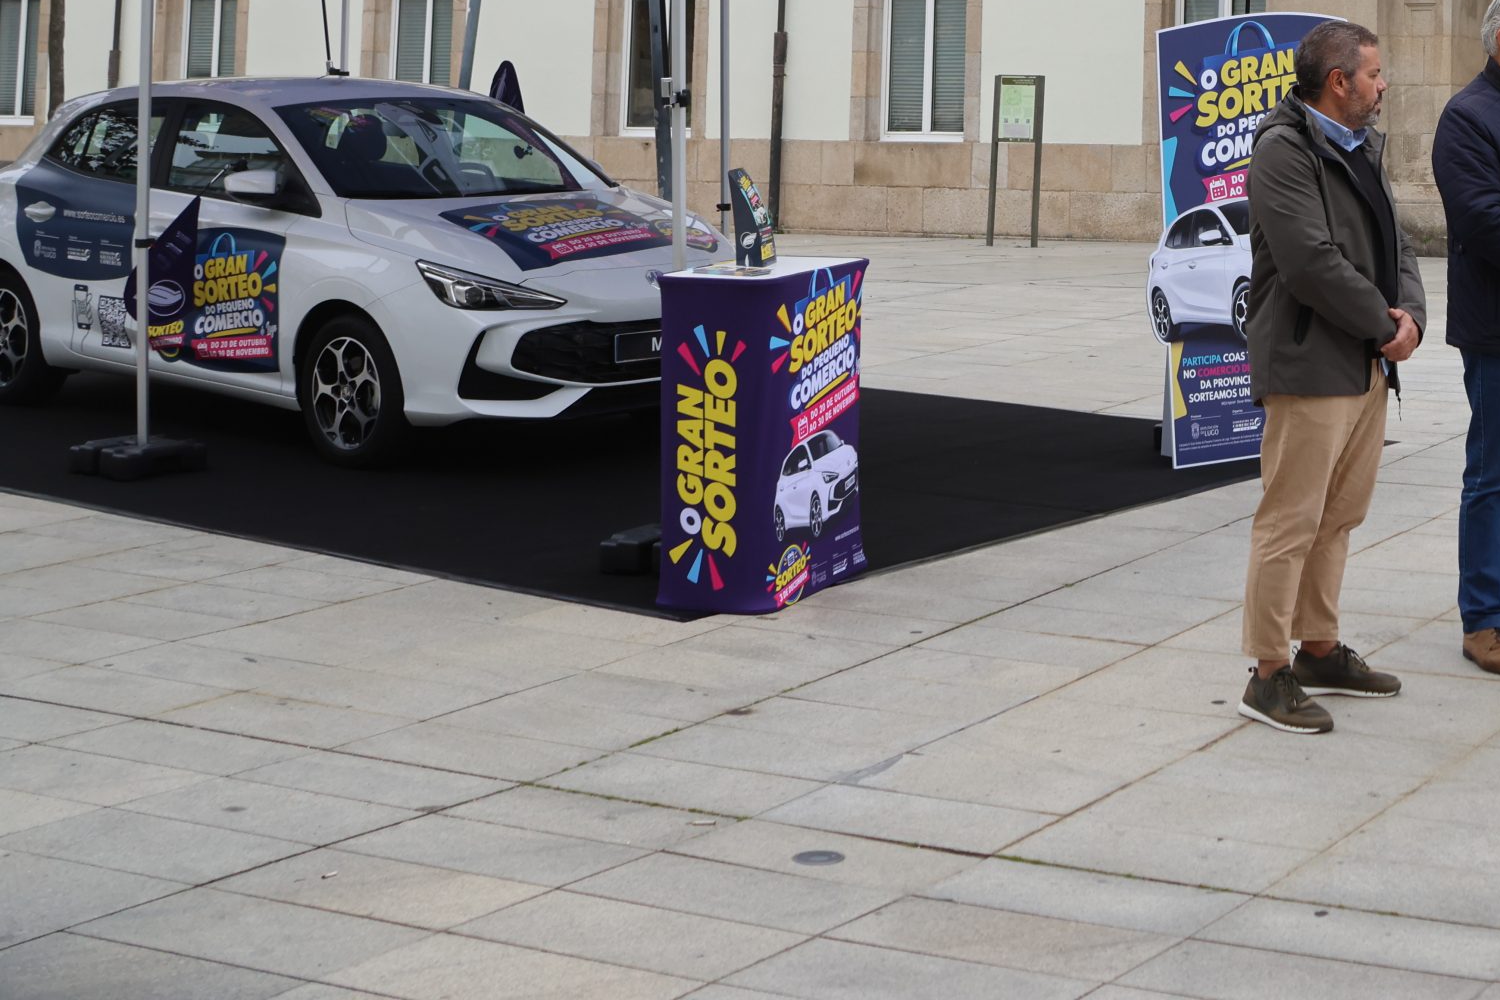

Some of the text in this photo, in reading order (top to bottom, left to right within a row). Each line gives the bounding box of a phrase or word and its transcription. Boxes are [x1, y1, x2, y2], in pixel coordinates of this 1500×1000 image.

[1200, 48, 1295, 90] O GRAN
[1217, 122, 1236, 138] DO
[1231, 173, 1245, 185] DO
[1229, 187, 1242, 197] AO
[501, 208, 604, 231] SORTEO
[506, 204, 569, 219] GRAN
[528, 219, 625, 243] COMERCIO
[604, 229, 641, 239] OUTUBRO
[193, 253, 248, 280] O GRAN
[193, 272, 263, 307] SORTEO
[205, 298, 255, 315] DO PEQUENO
[793, 281, 845, 335] O GRAN
[194, 308, 264, 335] COMERCIO
[239, 338, 267, 347] OUTUBRO
[789, 298, 857, 374] SORTEO
[801, 334, 849, 380] DO PEQUENO
[1182, 352, 1245, 367] PARTICIPA COAS
[790, 344, 855, 410] COMERCIO
[1183, 365, 1240, 379] NO COMERCIO
[1188, 389, 1238, 403] SORTEAMOS
[1238, 386, 1251, 397] UN
[1200, 379, 1212, 390] DA
[810, 380, 856, 420] DO 20 DE OUTUBRO
[809, 409, 832, 433] AO 30 DE
[677, 383, 704, 535] O GRAN
[701, 359, 737, 558] SORTEO
[775, 555, 807, 592] SORTEO
